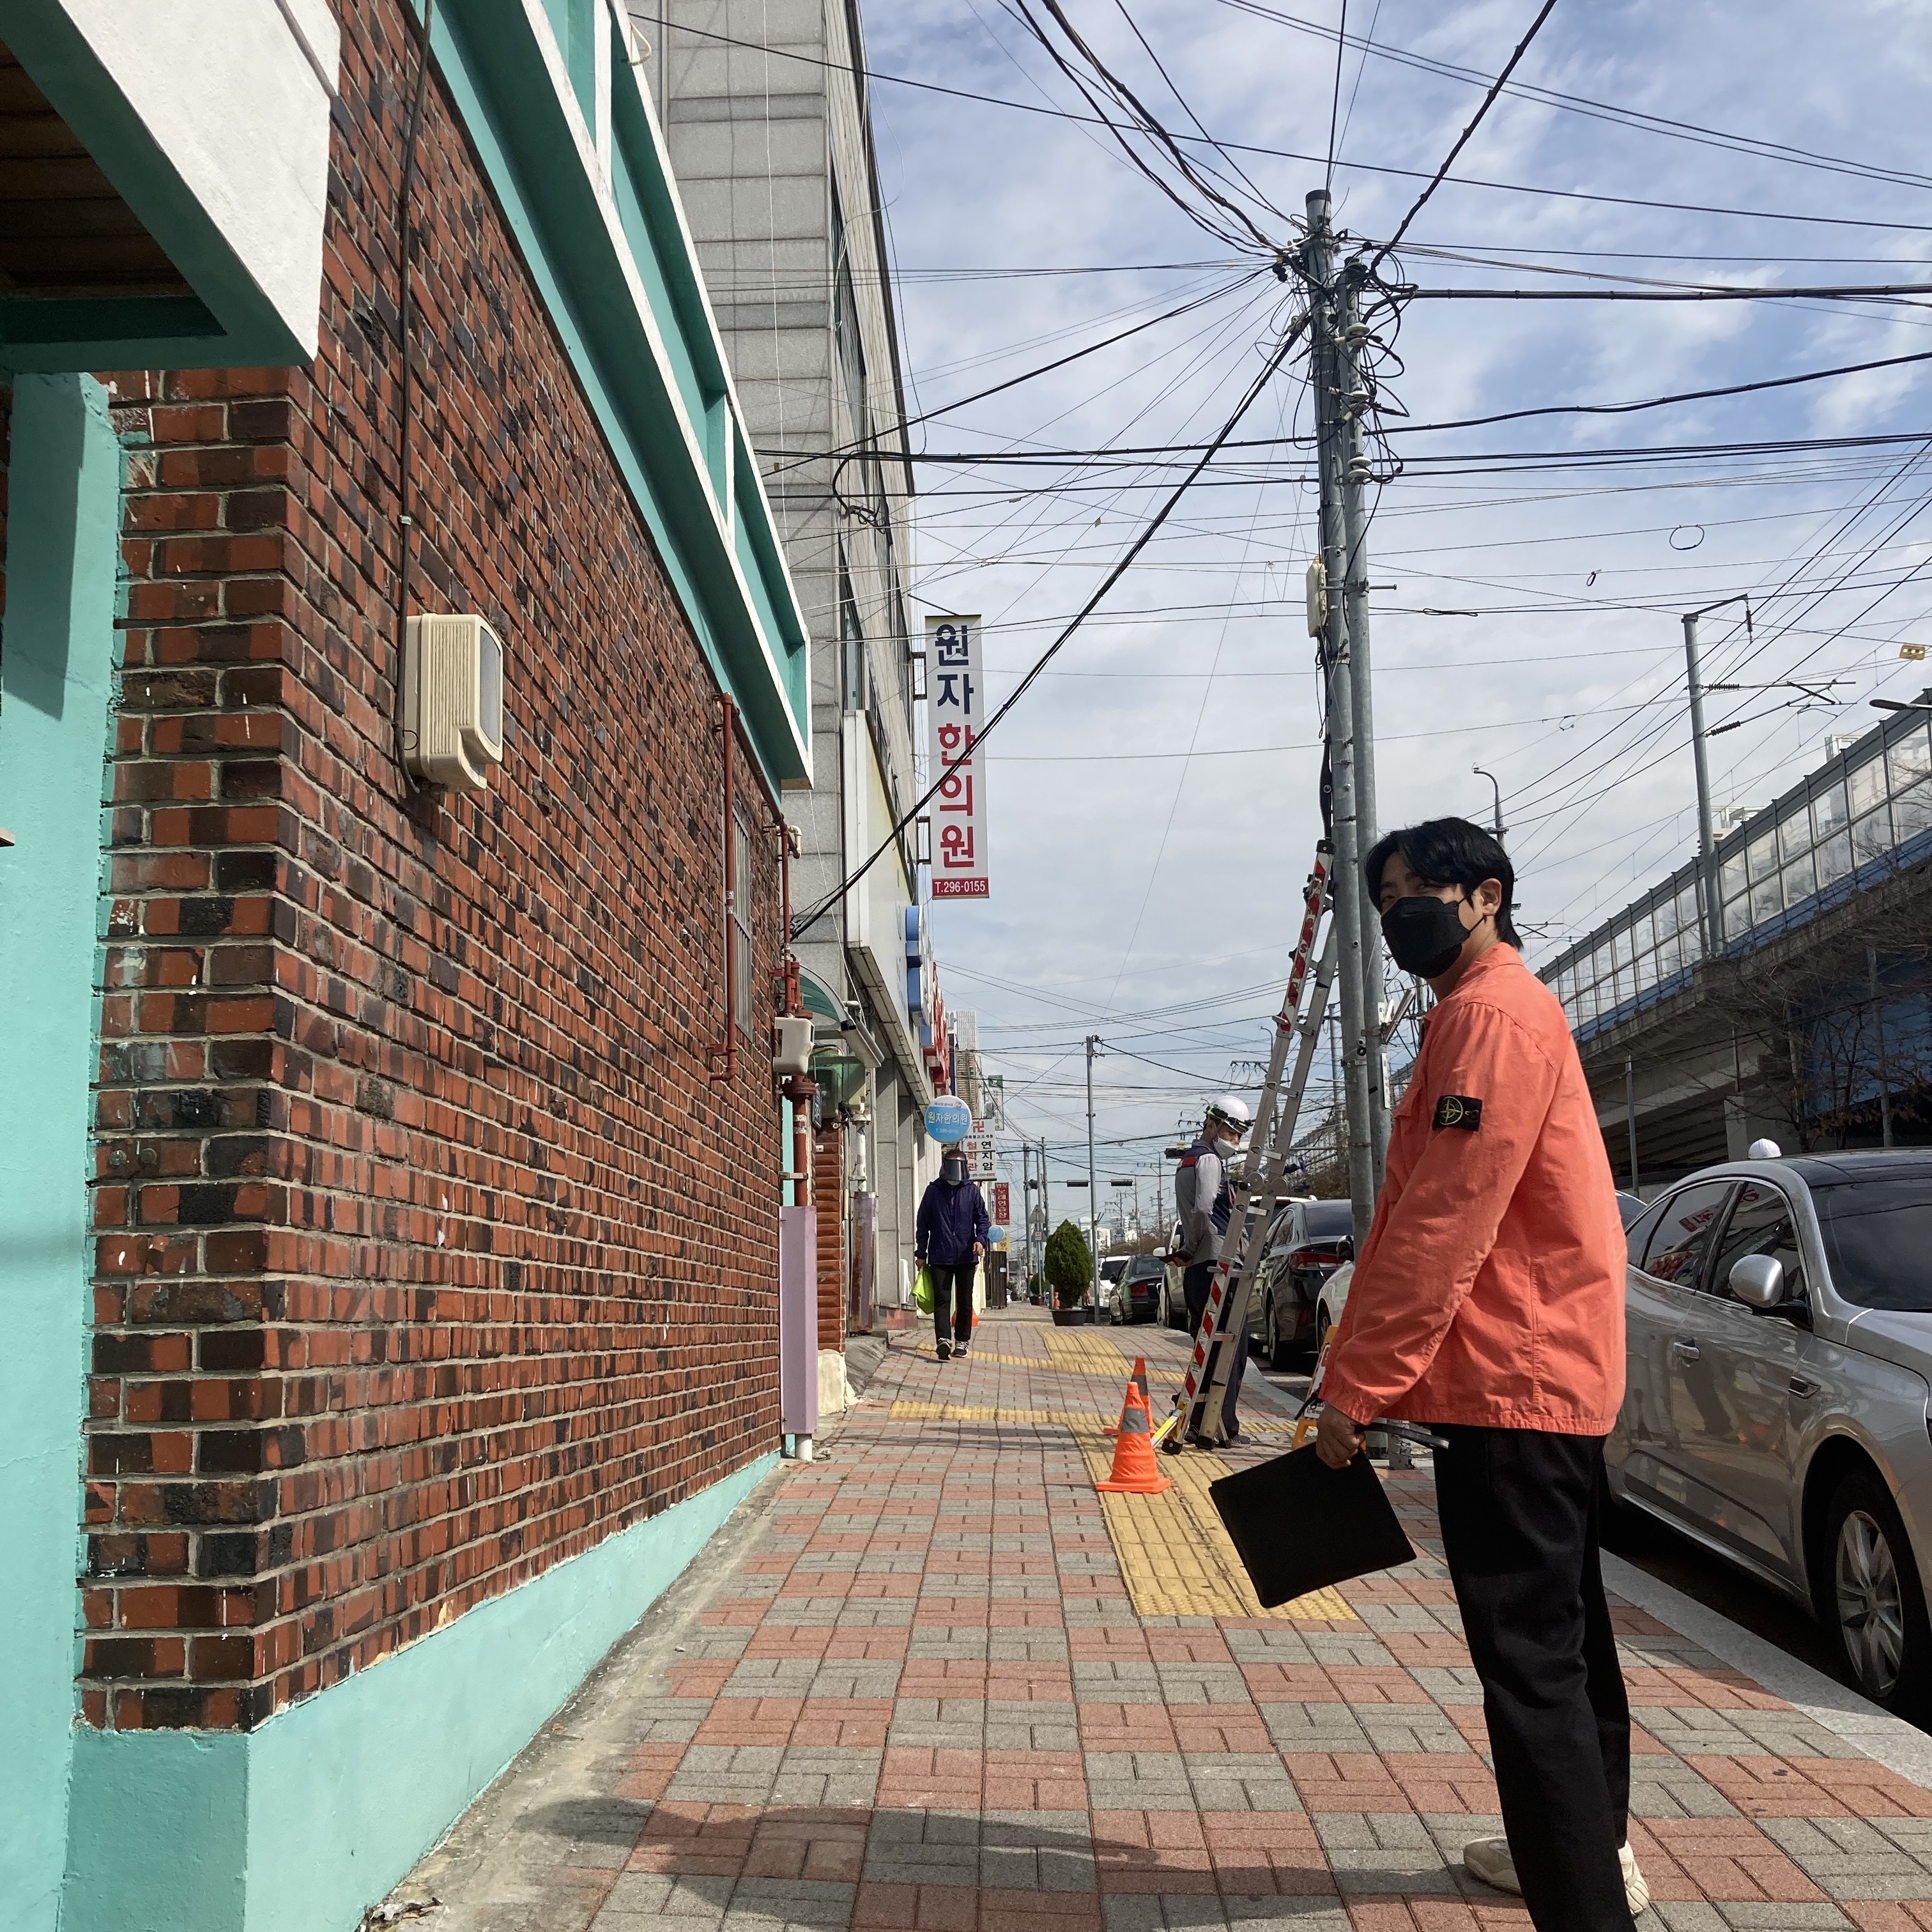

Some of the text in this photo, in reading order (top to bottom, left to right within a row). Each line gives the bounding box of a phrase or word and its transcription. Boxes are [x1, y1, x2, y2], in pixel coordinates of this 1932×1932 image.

[935, 624, 975, 868] 원자한의원
[935, 880, 985, 894] T.296-0155
[928, 1111, 968, 1126] 원자한의원
[981, 1141, 994, 1171] 연지암
